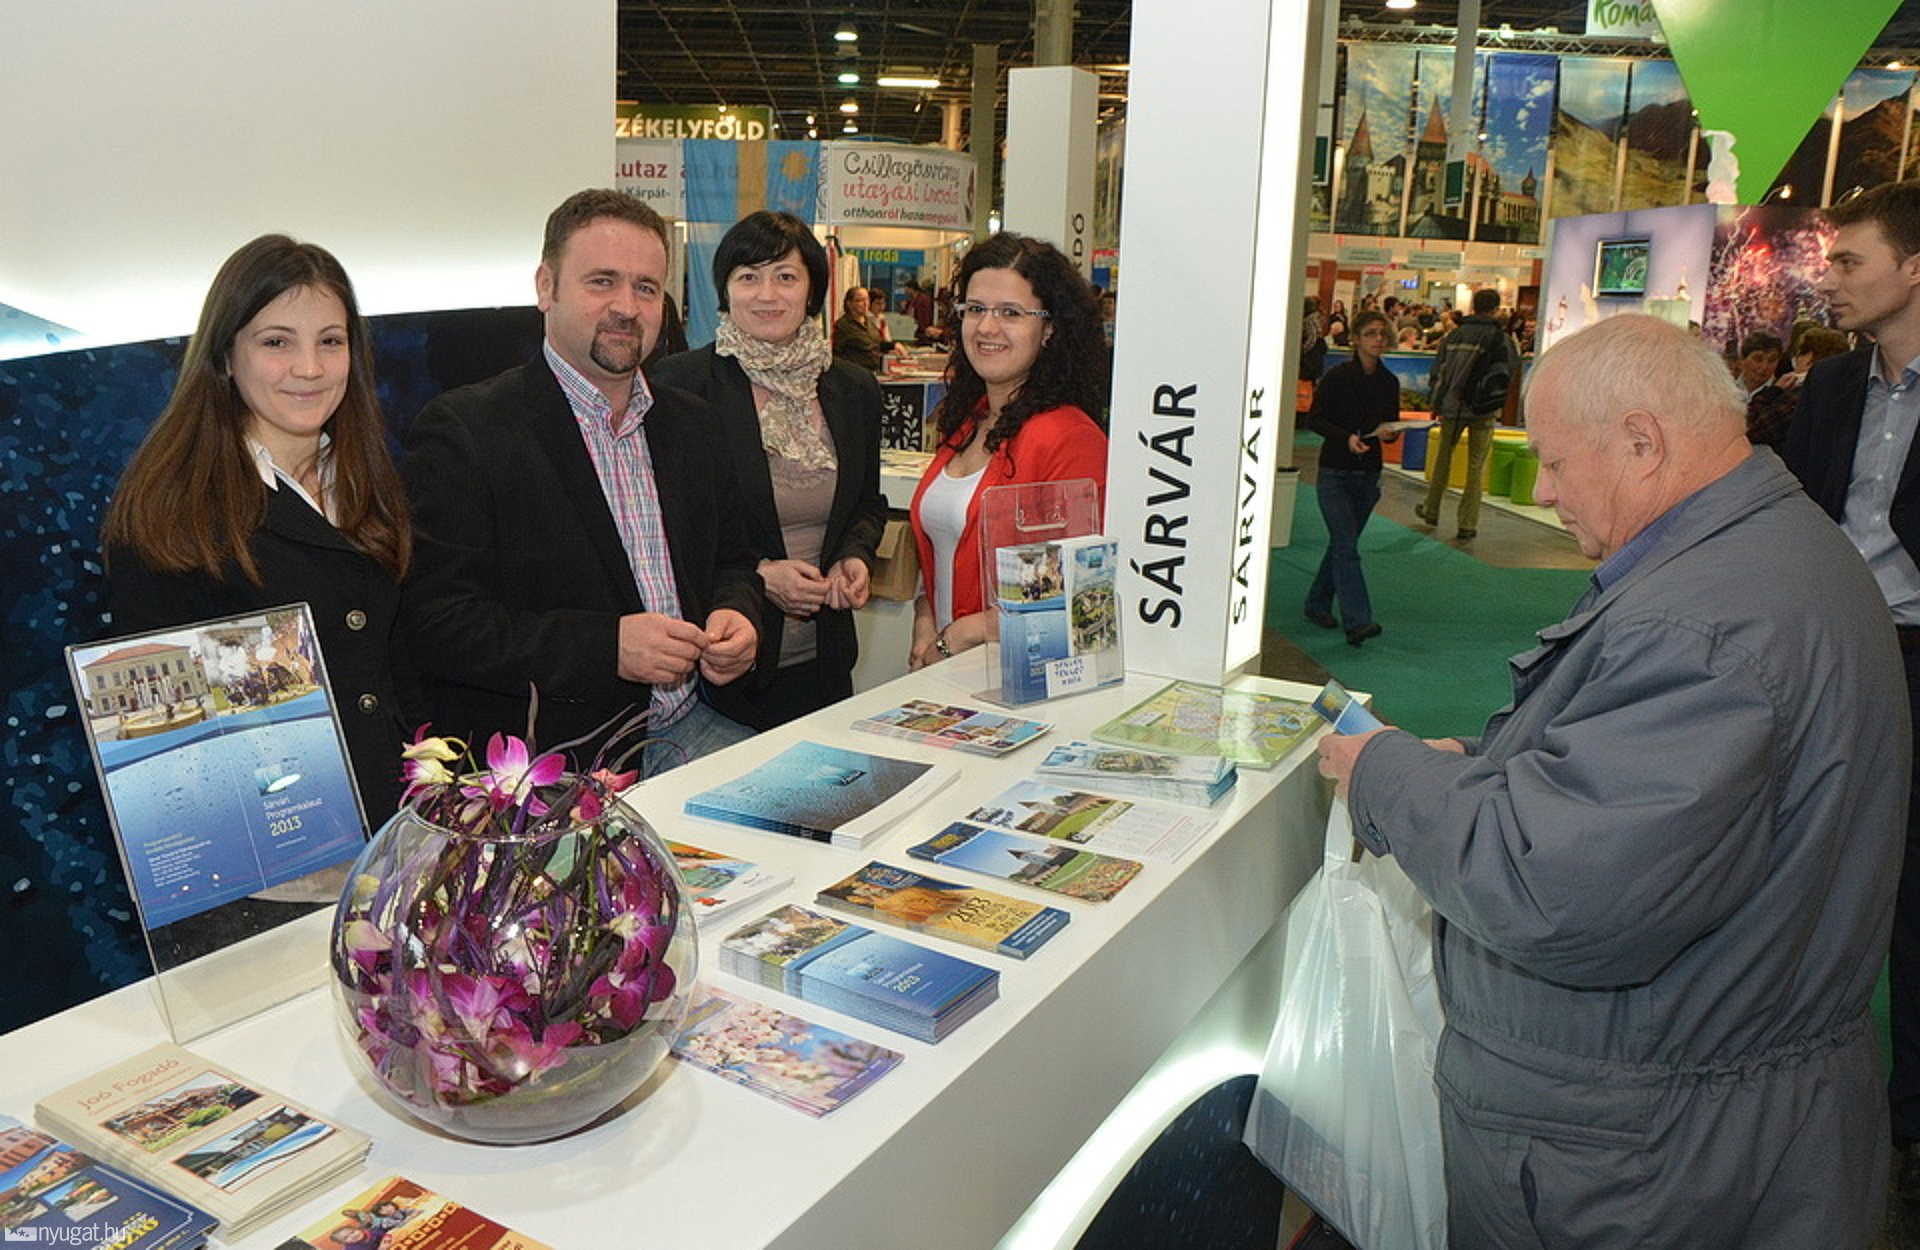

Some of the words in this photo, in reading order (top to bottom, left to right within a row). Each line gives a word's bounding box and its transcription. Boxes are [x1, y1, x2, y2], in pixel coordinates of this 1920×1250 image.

[1129, 384, 1197, 628] SÁRVÁR
[1232, 387, 1264, 624] SÁRVÁR
[269, 815, 303, 837] 2013
[946, 895, 991, 922] 2013
